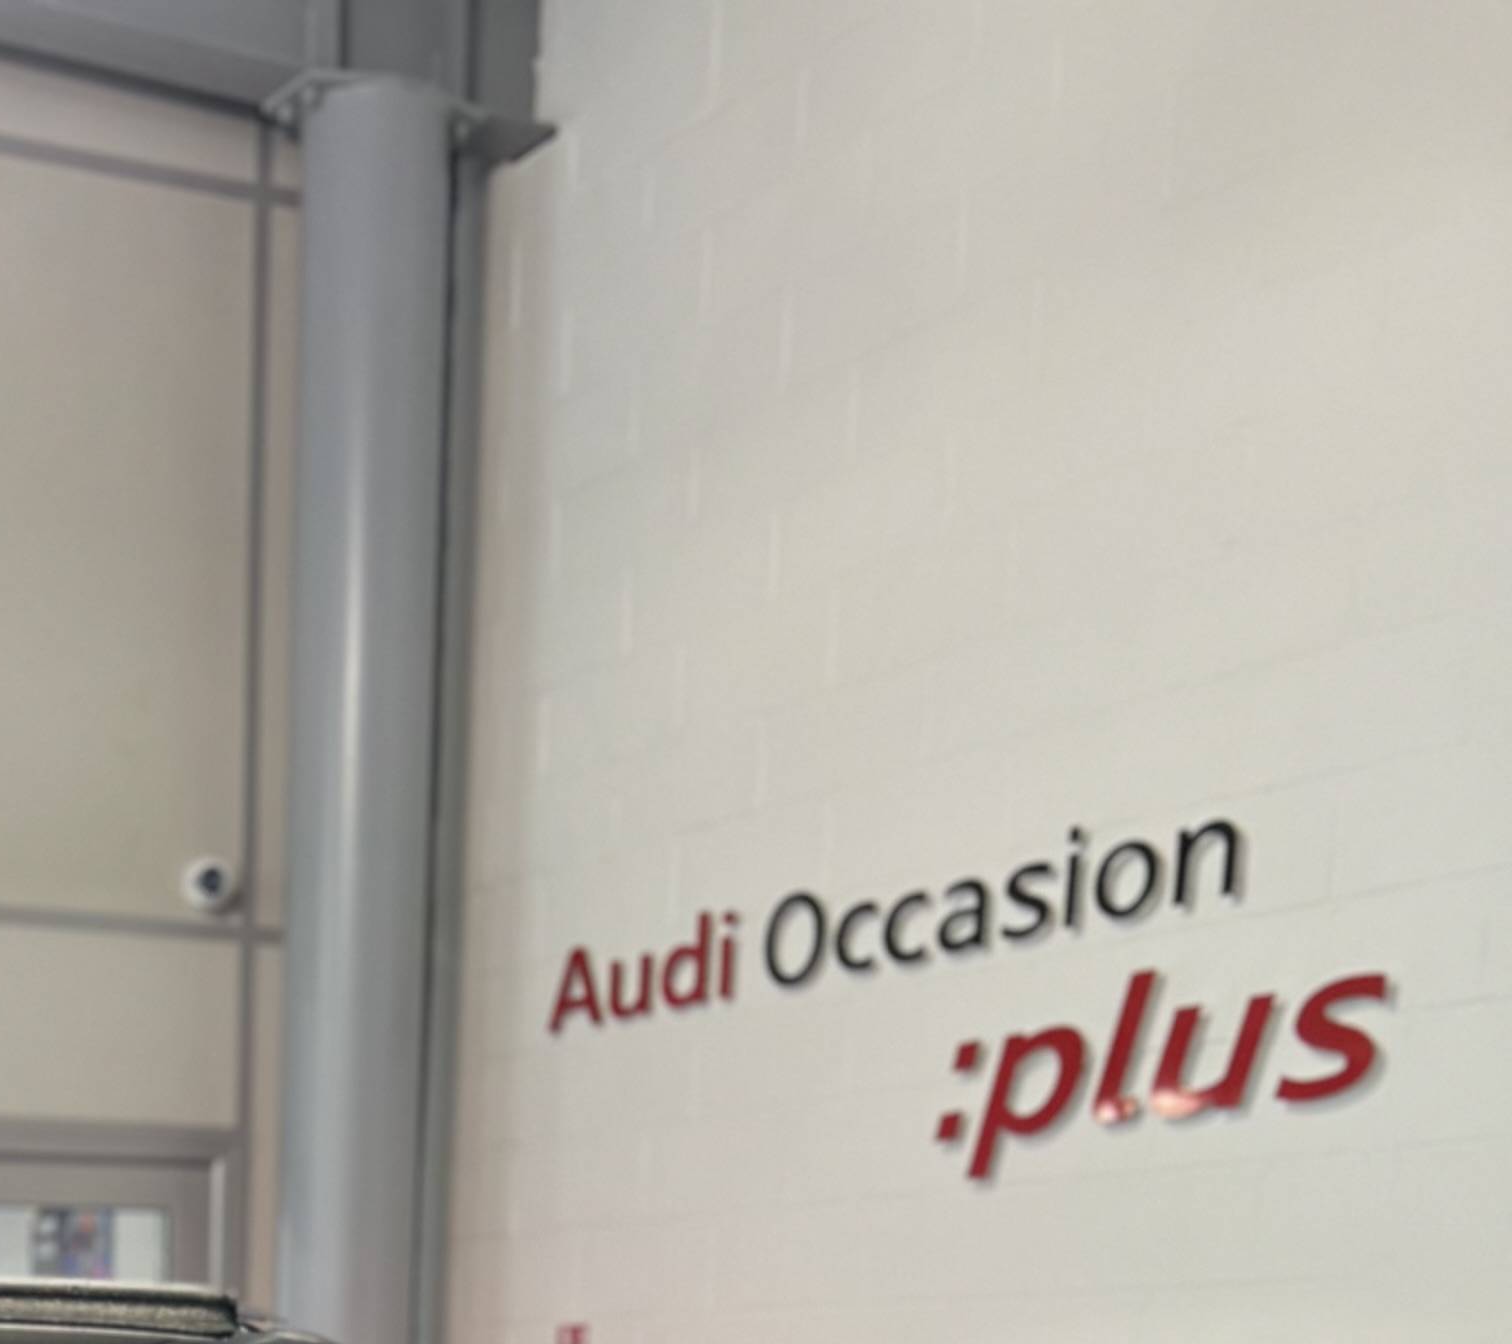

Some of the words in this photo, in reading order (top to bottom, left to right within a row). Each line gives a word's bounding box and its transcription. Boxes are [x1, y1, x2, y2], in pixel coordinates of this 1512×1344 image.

[549, 914, 741, 1032] Audi
[764, 818, 1244, 988] Occasion
[935, 969, 1388, 1180] :plus
